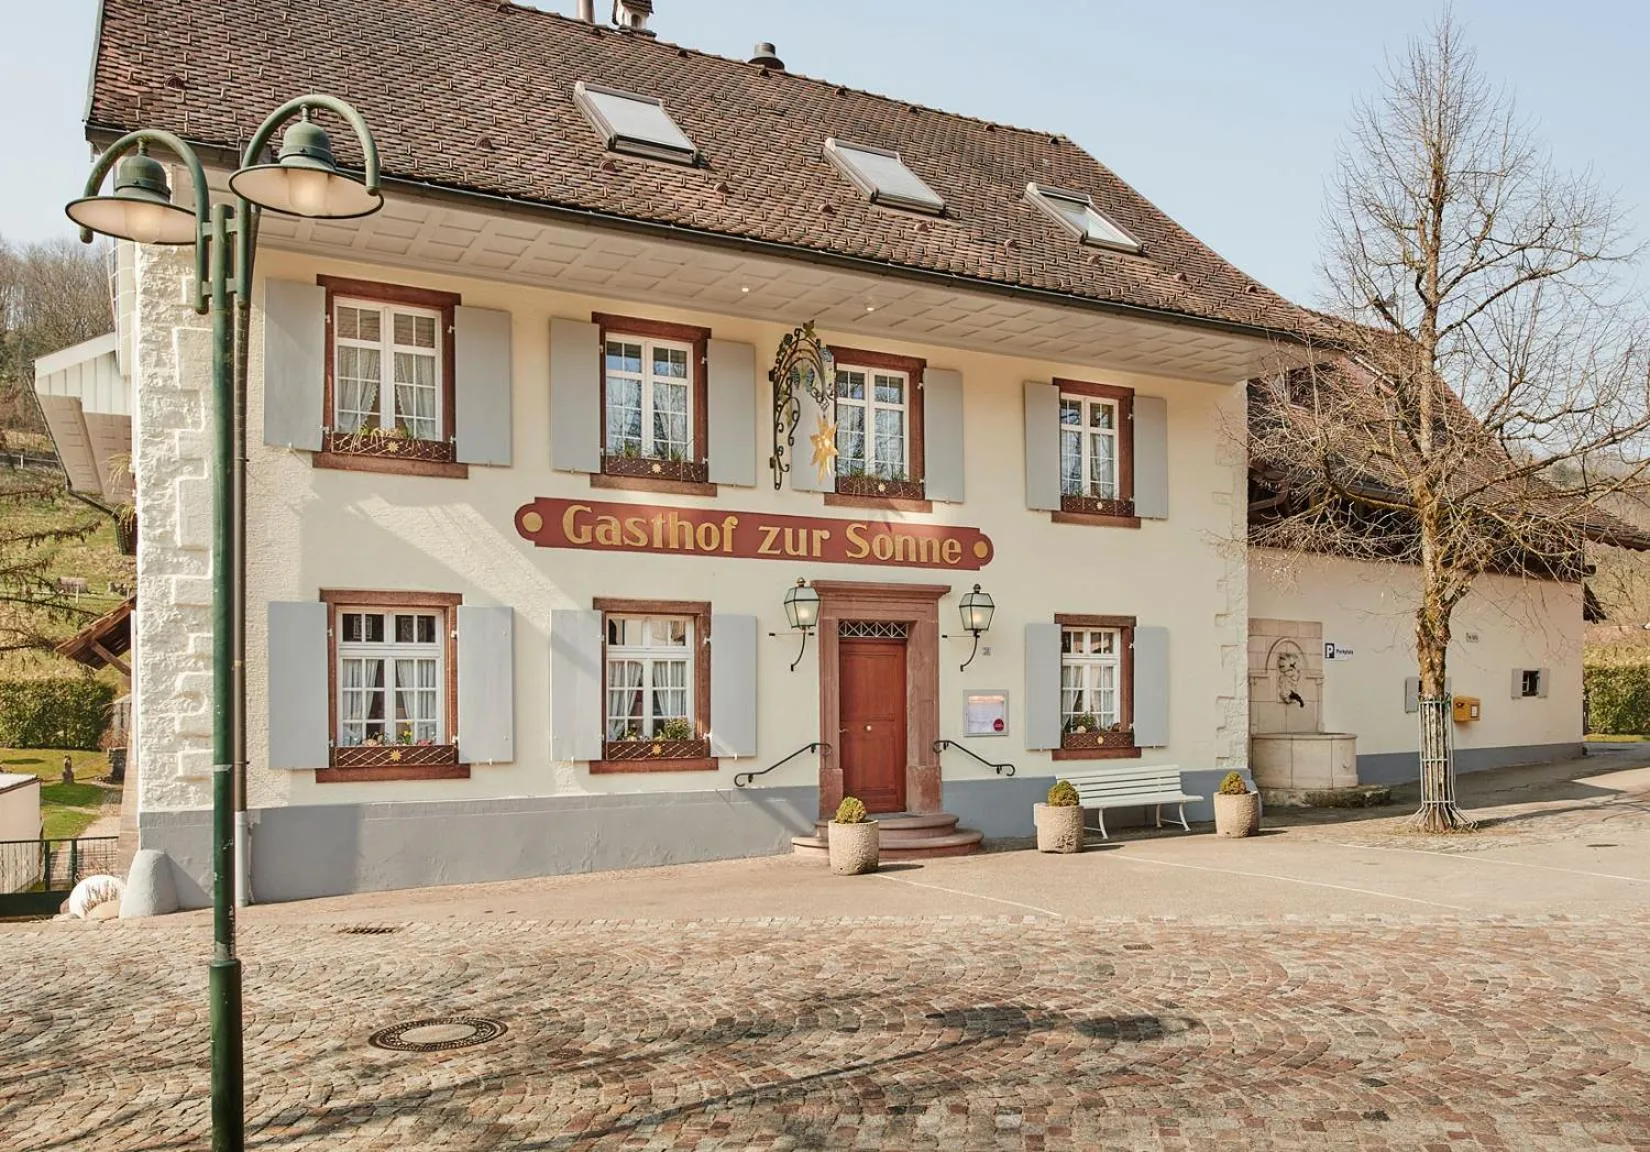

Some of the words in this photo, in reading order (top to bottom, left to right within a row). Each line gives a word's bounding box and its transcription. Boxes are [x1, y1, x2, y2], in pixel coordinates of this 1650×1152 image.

[563, 504, 739, 553] Gasthof
[757, 525, 831, 557] zur
[844, 524, 962, 564] Sonne
